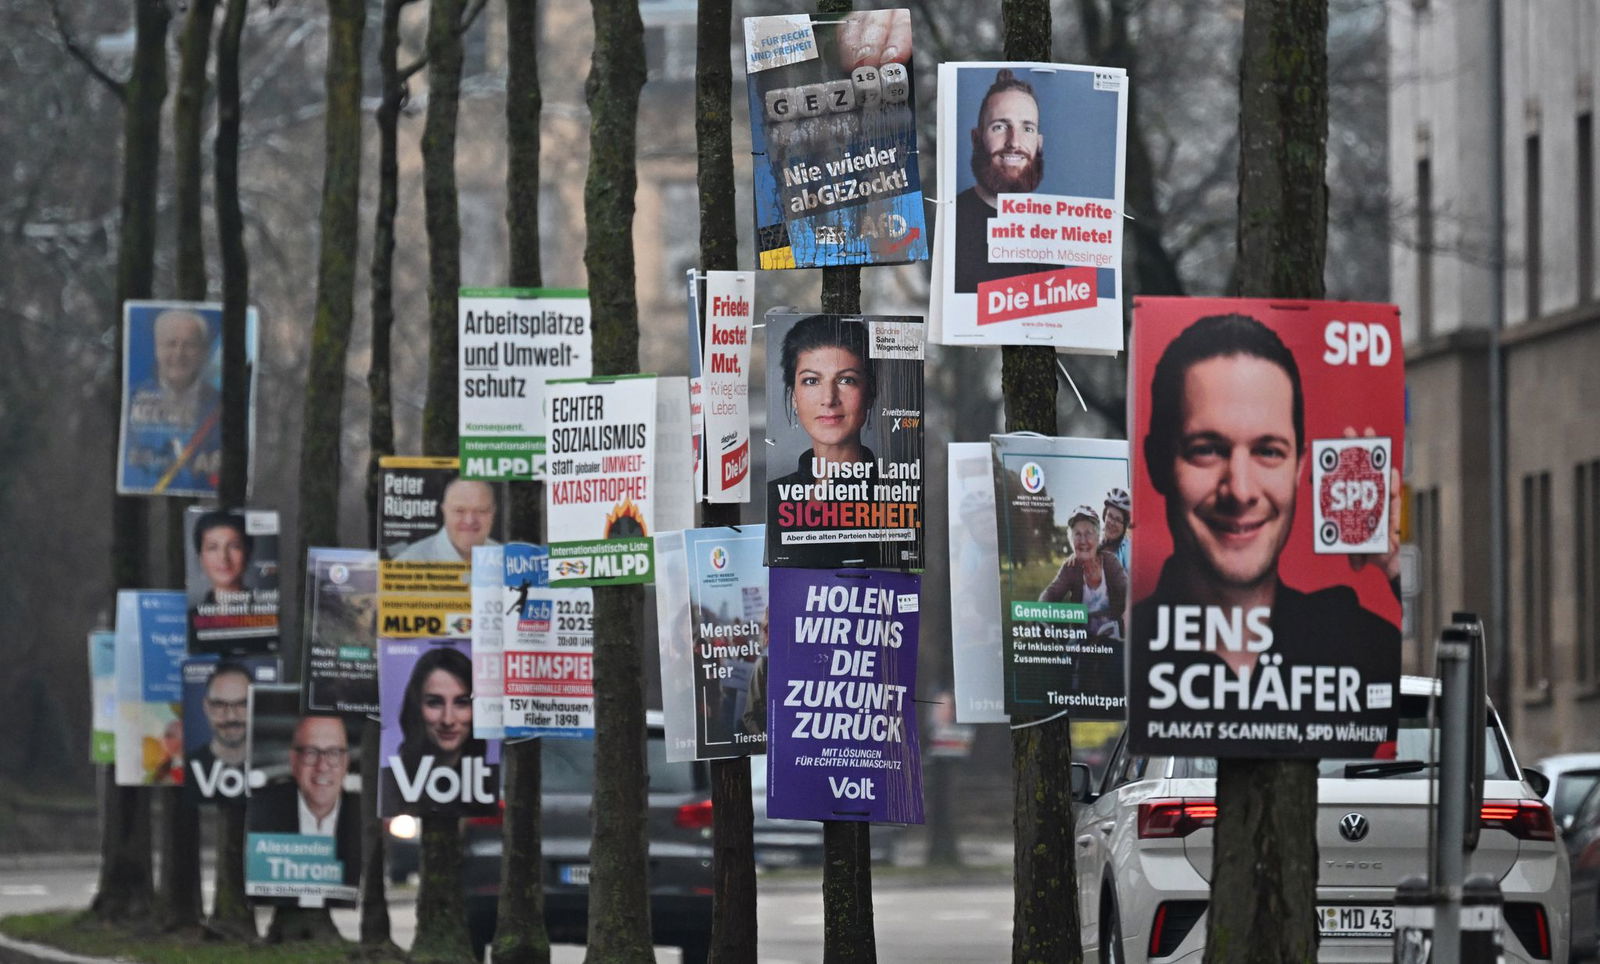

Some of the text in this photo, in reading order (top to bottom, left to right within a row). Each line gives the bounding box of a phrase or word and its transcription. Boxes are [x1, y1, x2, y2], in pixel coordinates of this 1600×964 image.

[761, 29, 810, 47] FÜR RECHT
[751, 40, 812, 62] UND FREIHEIT
[856, 68, 902, 83] 18 36
[783, 147, 898, 188] Nie wieder
[790, 168, 908, 214] abGEZockt!
[1002, 199, 1113, 220] Keine Profite
[860, 211, 907, 239] AfD
[991, 223, 1113, 244] mit der Miete!
[991, 246, 1113, 267] Christoph Mössinger
[988, 276, 1091, 315] Die Linke
[464, 310, 584, 338] Arbeitsplätze
[876, 336, 896, 344] Sahra
[876, 344, 919, 352] Wagenknecht
[1323, 320, 1391, 366] SPD
[464, 342, 580, 367] und Umwelt-
[711, 353, 741, 377] Mut,
[464, 373, 526, 398] schutz
[711, 381, 733, 399] Krieg
[552, 395, 604, 423] ECHTER
[882, 408, 920, 417] Zweitstimme
[901, 418, 920, 428] BSW
[552, 423, 646, 454] SOZIALISMUS
[466, 457, 529, 477] MLPD
[552, 455, 645, 476] statt globaler UMWELT-
[725, 460, 739, 482] Die
[812, 457, 920, 480] Unser Land
[384, 473, 424, 495] Peter
[552, 476, 647, 505] KATASTROPHE!
[778, 480, 920, 502] verdient mehr
[1330, 481, 1378, 511] SPD
[384, 497, 437, 519] Rügner
[778, 502, 921, 528] SICHERHEIT.
[806, 533, 817, 541] die
[888, 531, 911, 540] versagt!
[552, 542, 648, 556] Internationalistische Liste
[594, 553, 649, 577] MLPD
[527, 602, 550, 619] tsb
[557, 601, 593, 614] 22.02.
[805, 585, 894, 616] HOLEN
[1015, 604, 1085, 619] Gemeinsam
[384, 616, 442, 633] MLPD
[557, 618, 594, 631] 2025
[700, 620, 760, 638] Mensch
[795, 616, 904, 649] WIR UNS
[1013, 625, 1087, 639] statt einsam
[1149, 605, 1274, 653] JENS
[557, 636, 577, 646] 20:00
[701, 640, 761, 659] Umwelt
[1013, 641, 1113, 654] Für Inklusion und sozialen
[830, 650, 876, 677] DIE
[1014, 654, 1072, 665] Zusammenhalt
[703, 664, 734, 680] Tier
[1148, 653, 1361, 712] SCHÄFER
[510, 699, 528, 711] TSV
[784, 680, 907, 712] ZUKUNFT
[524, 713, 579, 726] Filder 1898
[792, 708, 901, 743] ZURÜCK
[1148, 722, 1388, 743] PLAKAT SCANNEN, SPD WÄHLEN!
[795, 756, 901, 770] FÜR ECHTEN KLIMASCHUTZ
[822, 747, 882, 759] MIT LÖSUNGEN
[388, 755, 495, 804] Volt
[829, 776, 876, 800] Volt
[256, 840, 329, 855] Alexander
[265, 857, 340, 879] Throm
[1326, 861, 1383, 869] T-ROC
[1340, 908, 1365, 929] MD
[1370, 908, 1393, 929] 43
